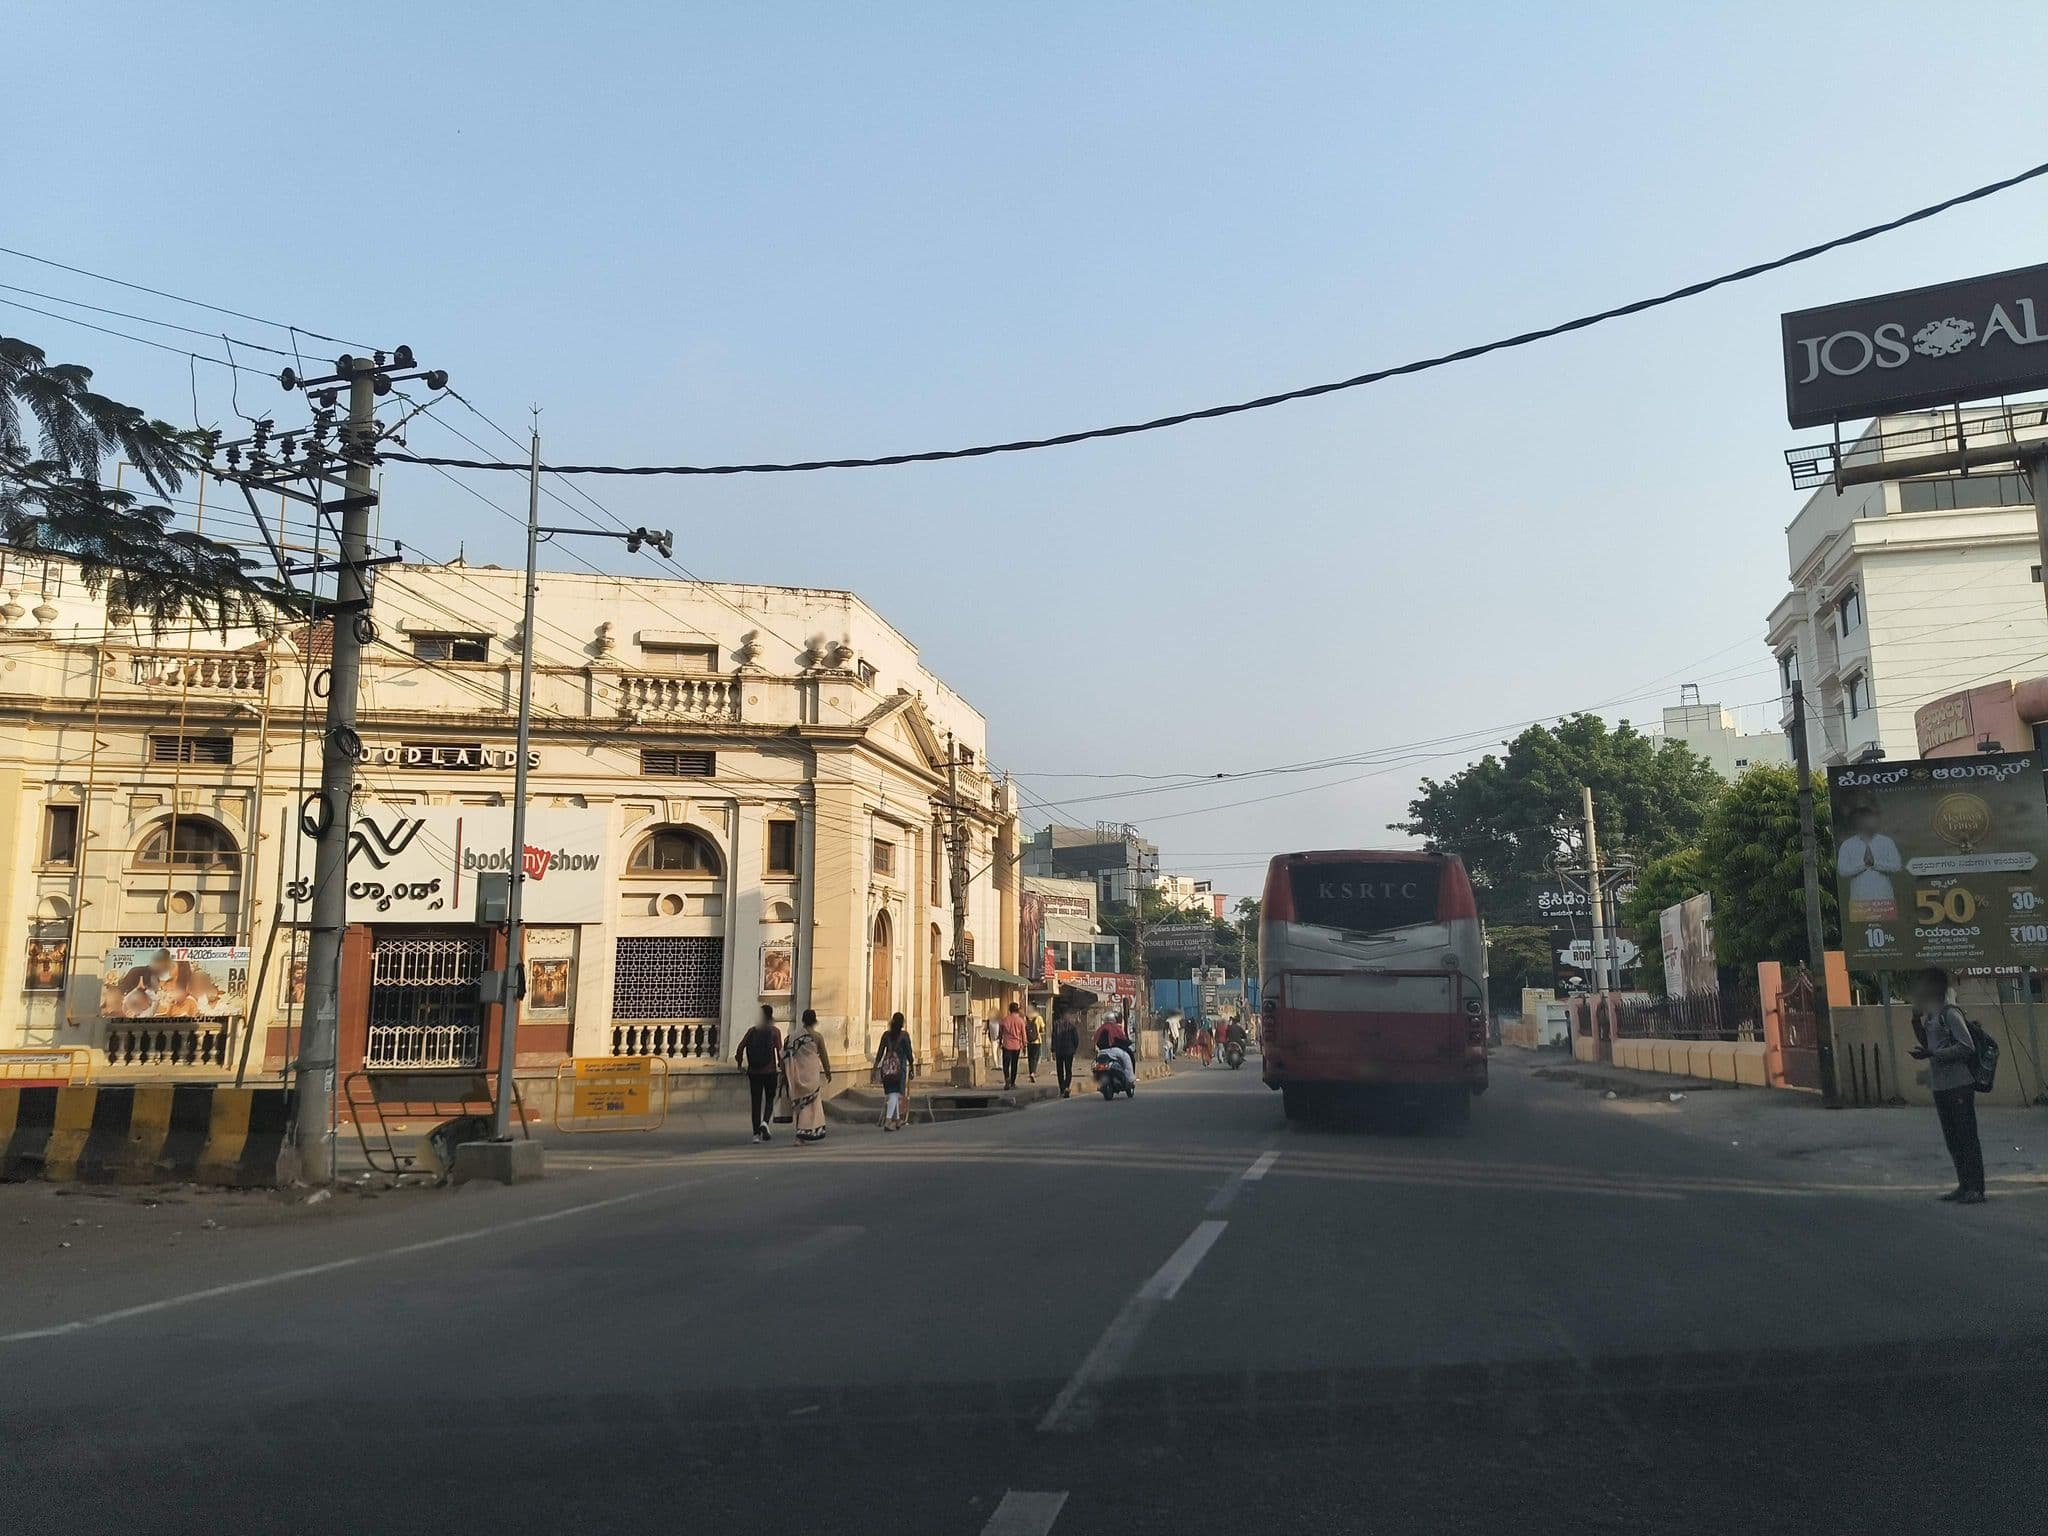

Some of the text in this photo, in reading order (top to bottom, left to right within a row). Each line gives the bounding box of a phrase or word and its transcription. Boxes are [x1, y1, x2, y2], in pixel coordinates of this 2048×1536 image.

[1797, 323, 1910, 384] JOS
[358, 746, 542, 768] OODLANDS
[1838, 758, 2031, 787] ಜೋಸ್ ಆಲುಕ್ಕಾಸ್
[1318, 882, 1418, 899] KSRTC
[2009, 925, 2048, 943] ₹100
[1968, 965, 2038, 975] LIDO CINEA
